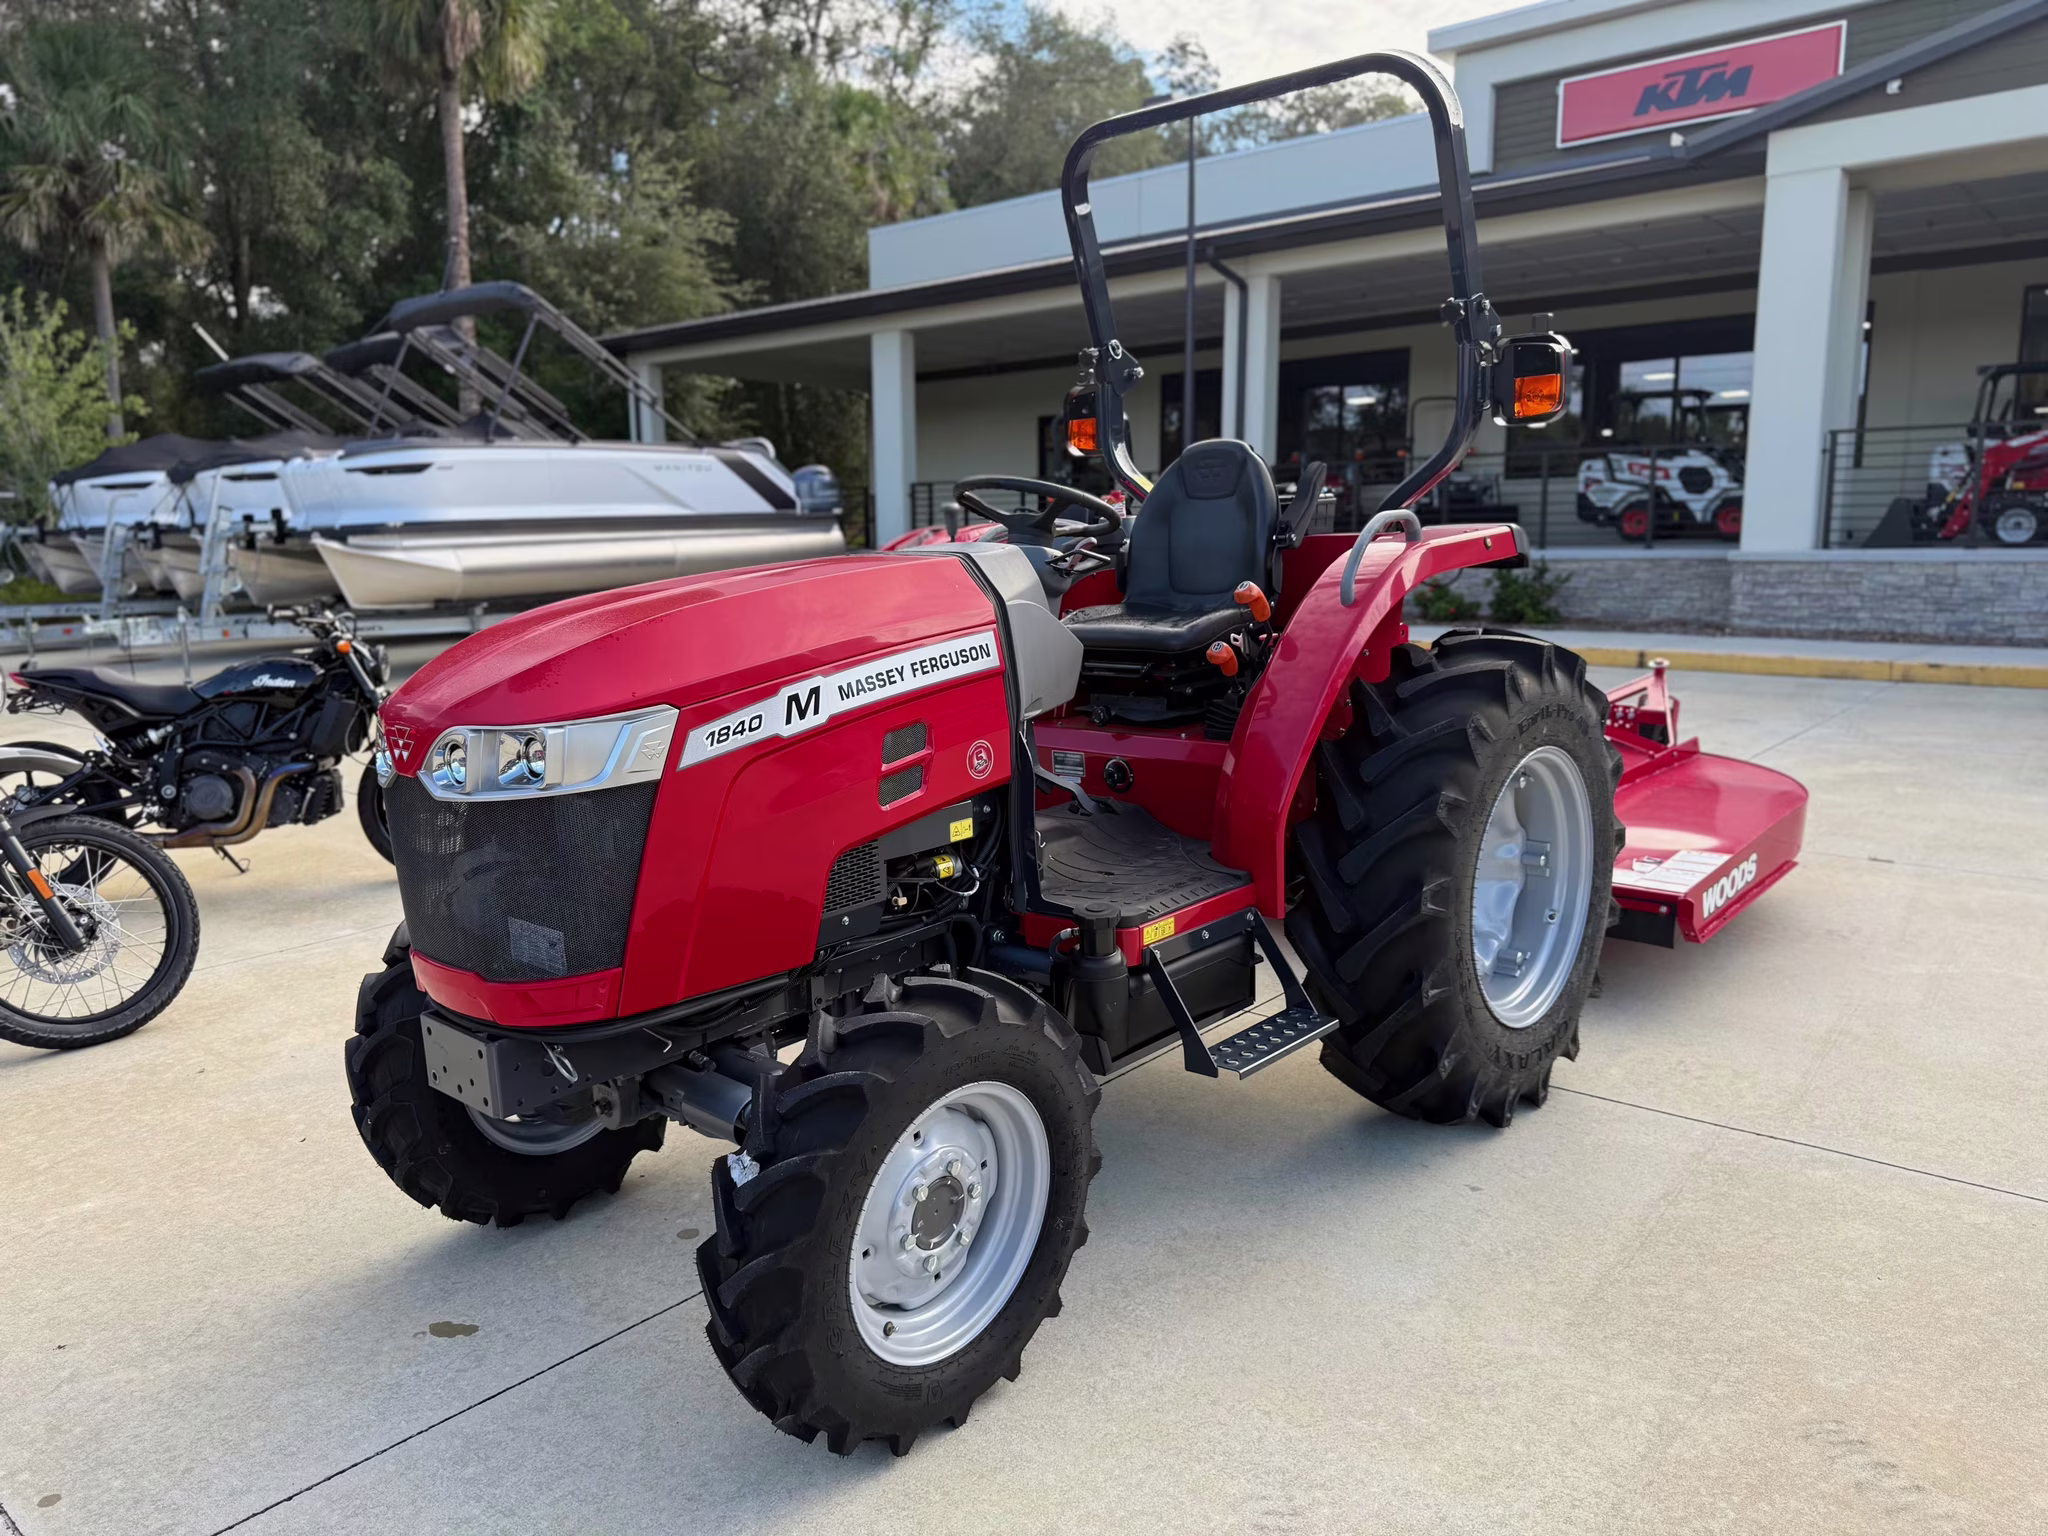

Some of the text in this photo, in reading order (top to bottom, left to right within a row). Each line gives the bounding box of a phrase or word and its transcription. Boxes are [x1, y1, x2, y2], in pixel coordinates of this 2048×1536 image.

[1634, 62, 1753, 116] KTM
[252, 673, 297, 688] Indian
[838, 643, 991, 702] MASSEY FERGUSON
[705, 713, 763, 748] 1840
[785, 685, 821, 726] M
[1702, 853, 1758, 919] WOODS
[822, 1152, 869, 1353] GALAXY
